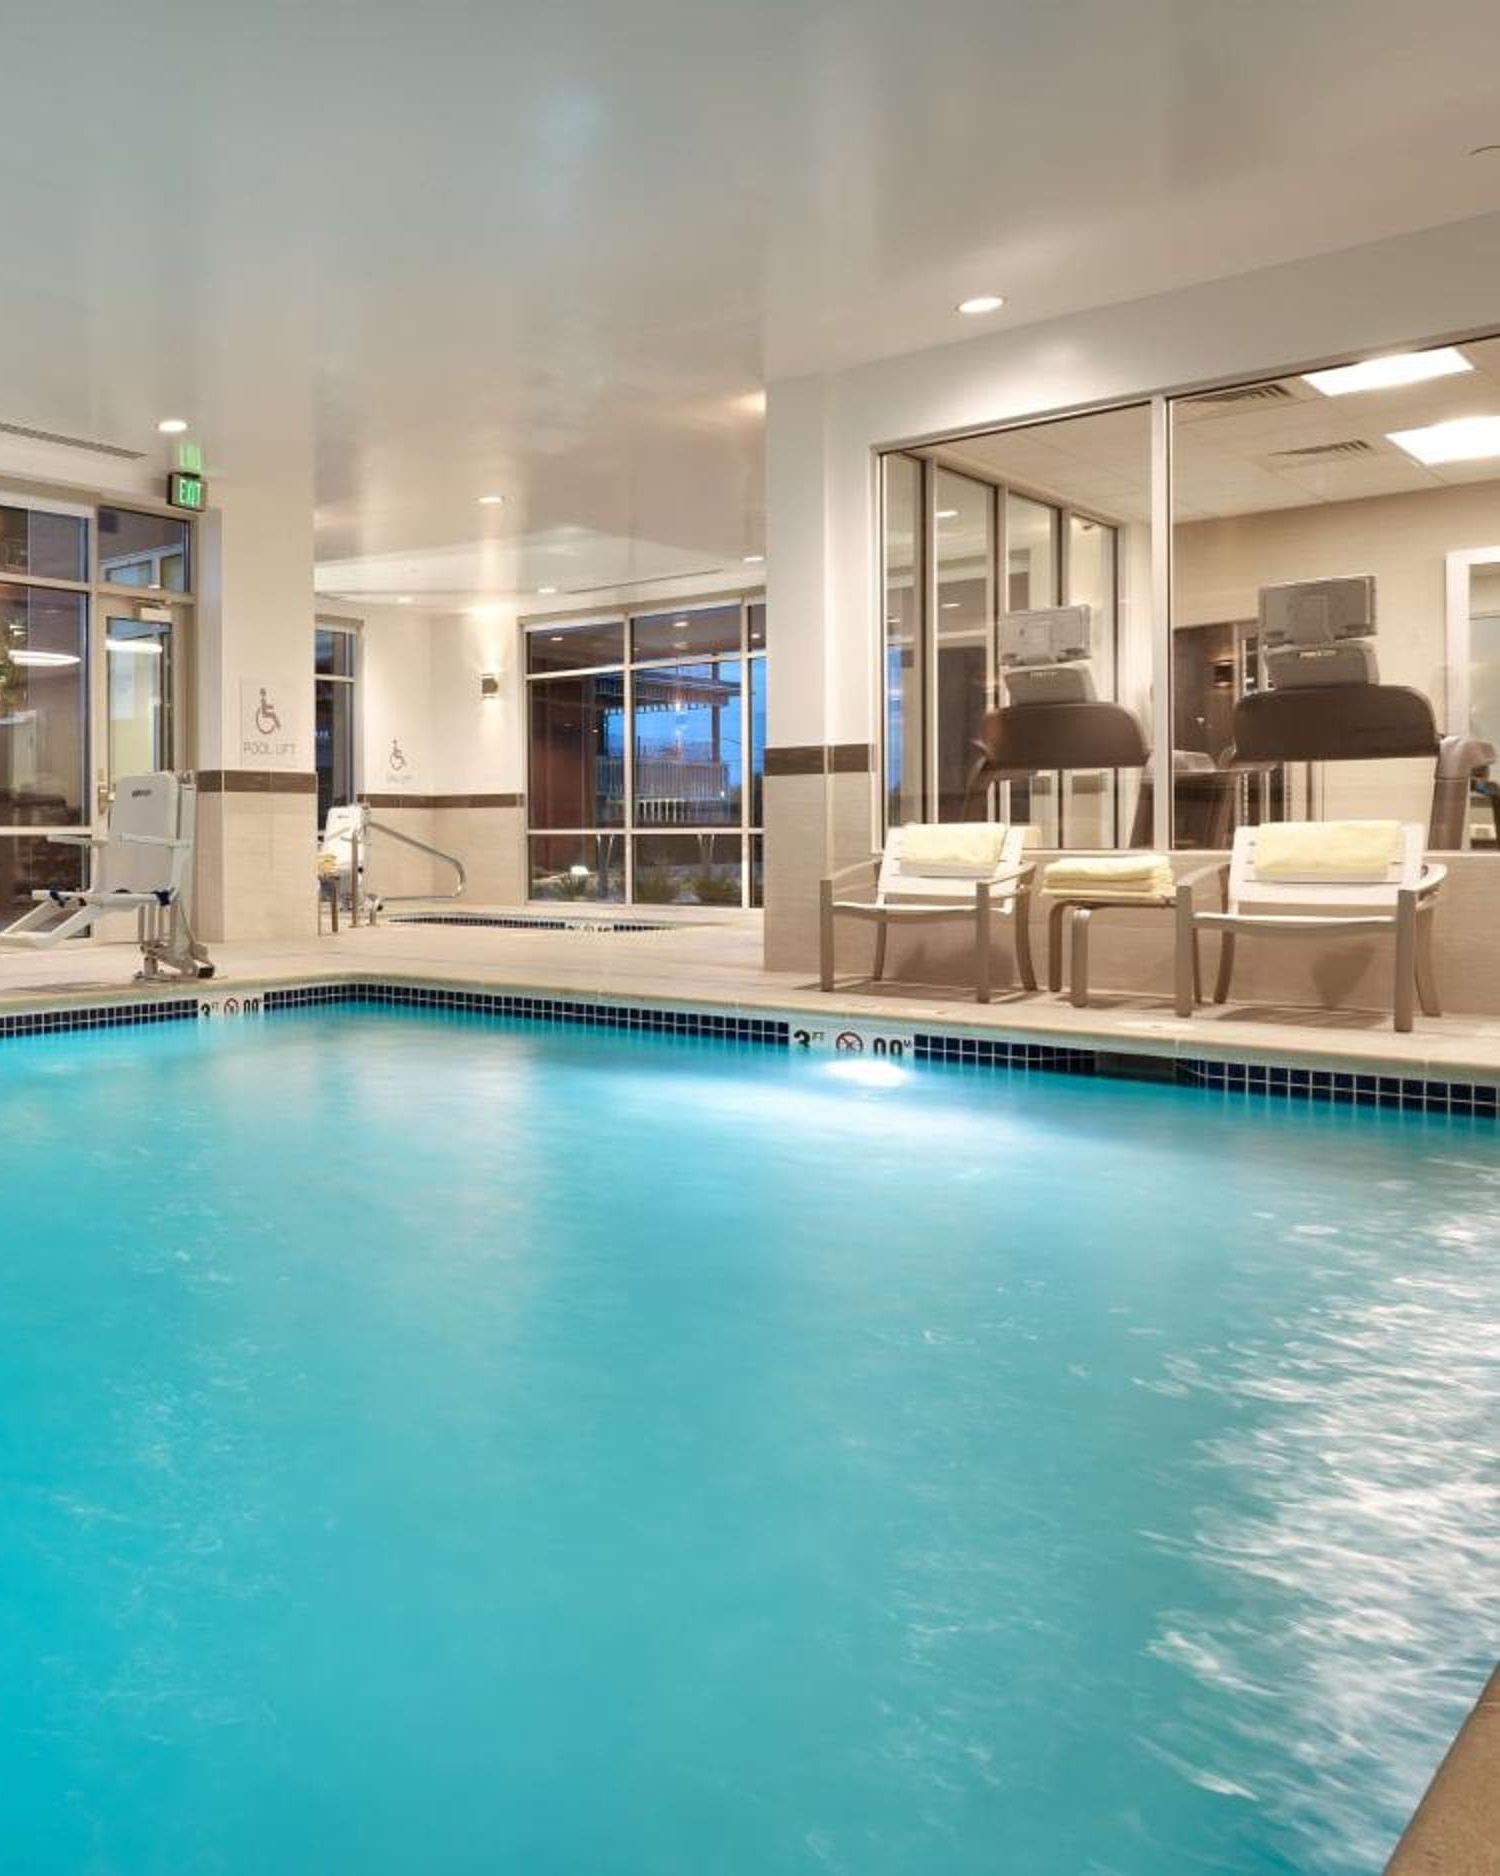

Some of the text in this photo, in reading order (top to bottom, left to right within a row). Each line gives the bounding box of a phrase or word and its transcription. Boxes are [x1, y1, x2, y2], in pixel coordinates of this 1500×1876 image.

[180, 479, 203, 508] EXIT
[243, 741, 297, 757] POOL LIFT
